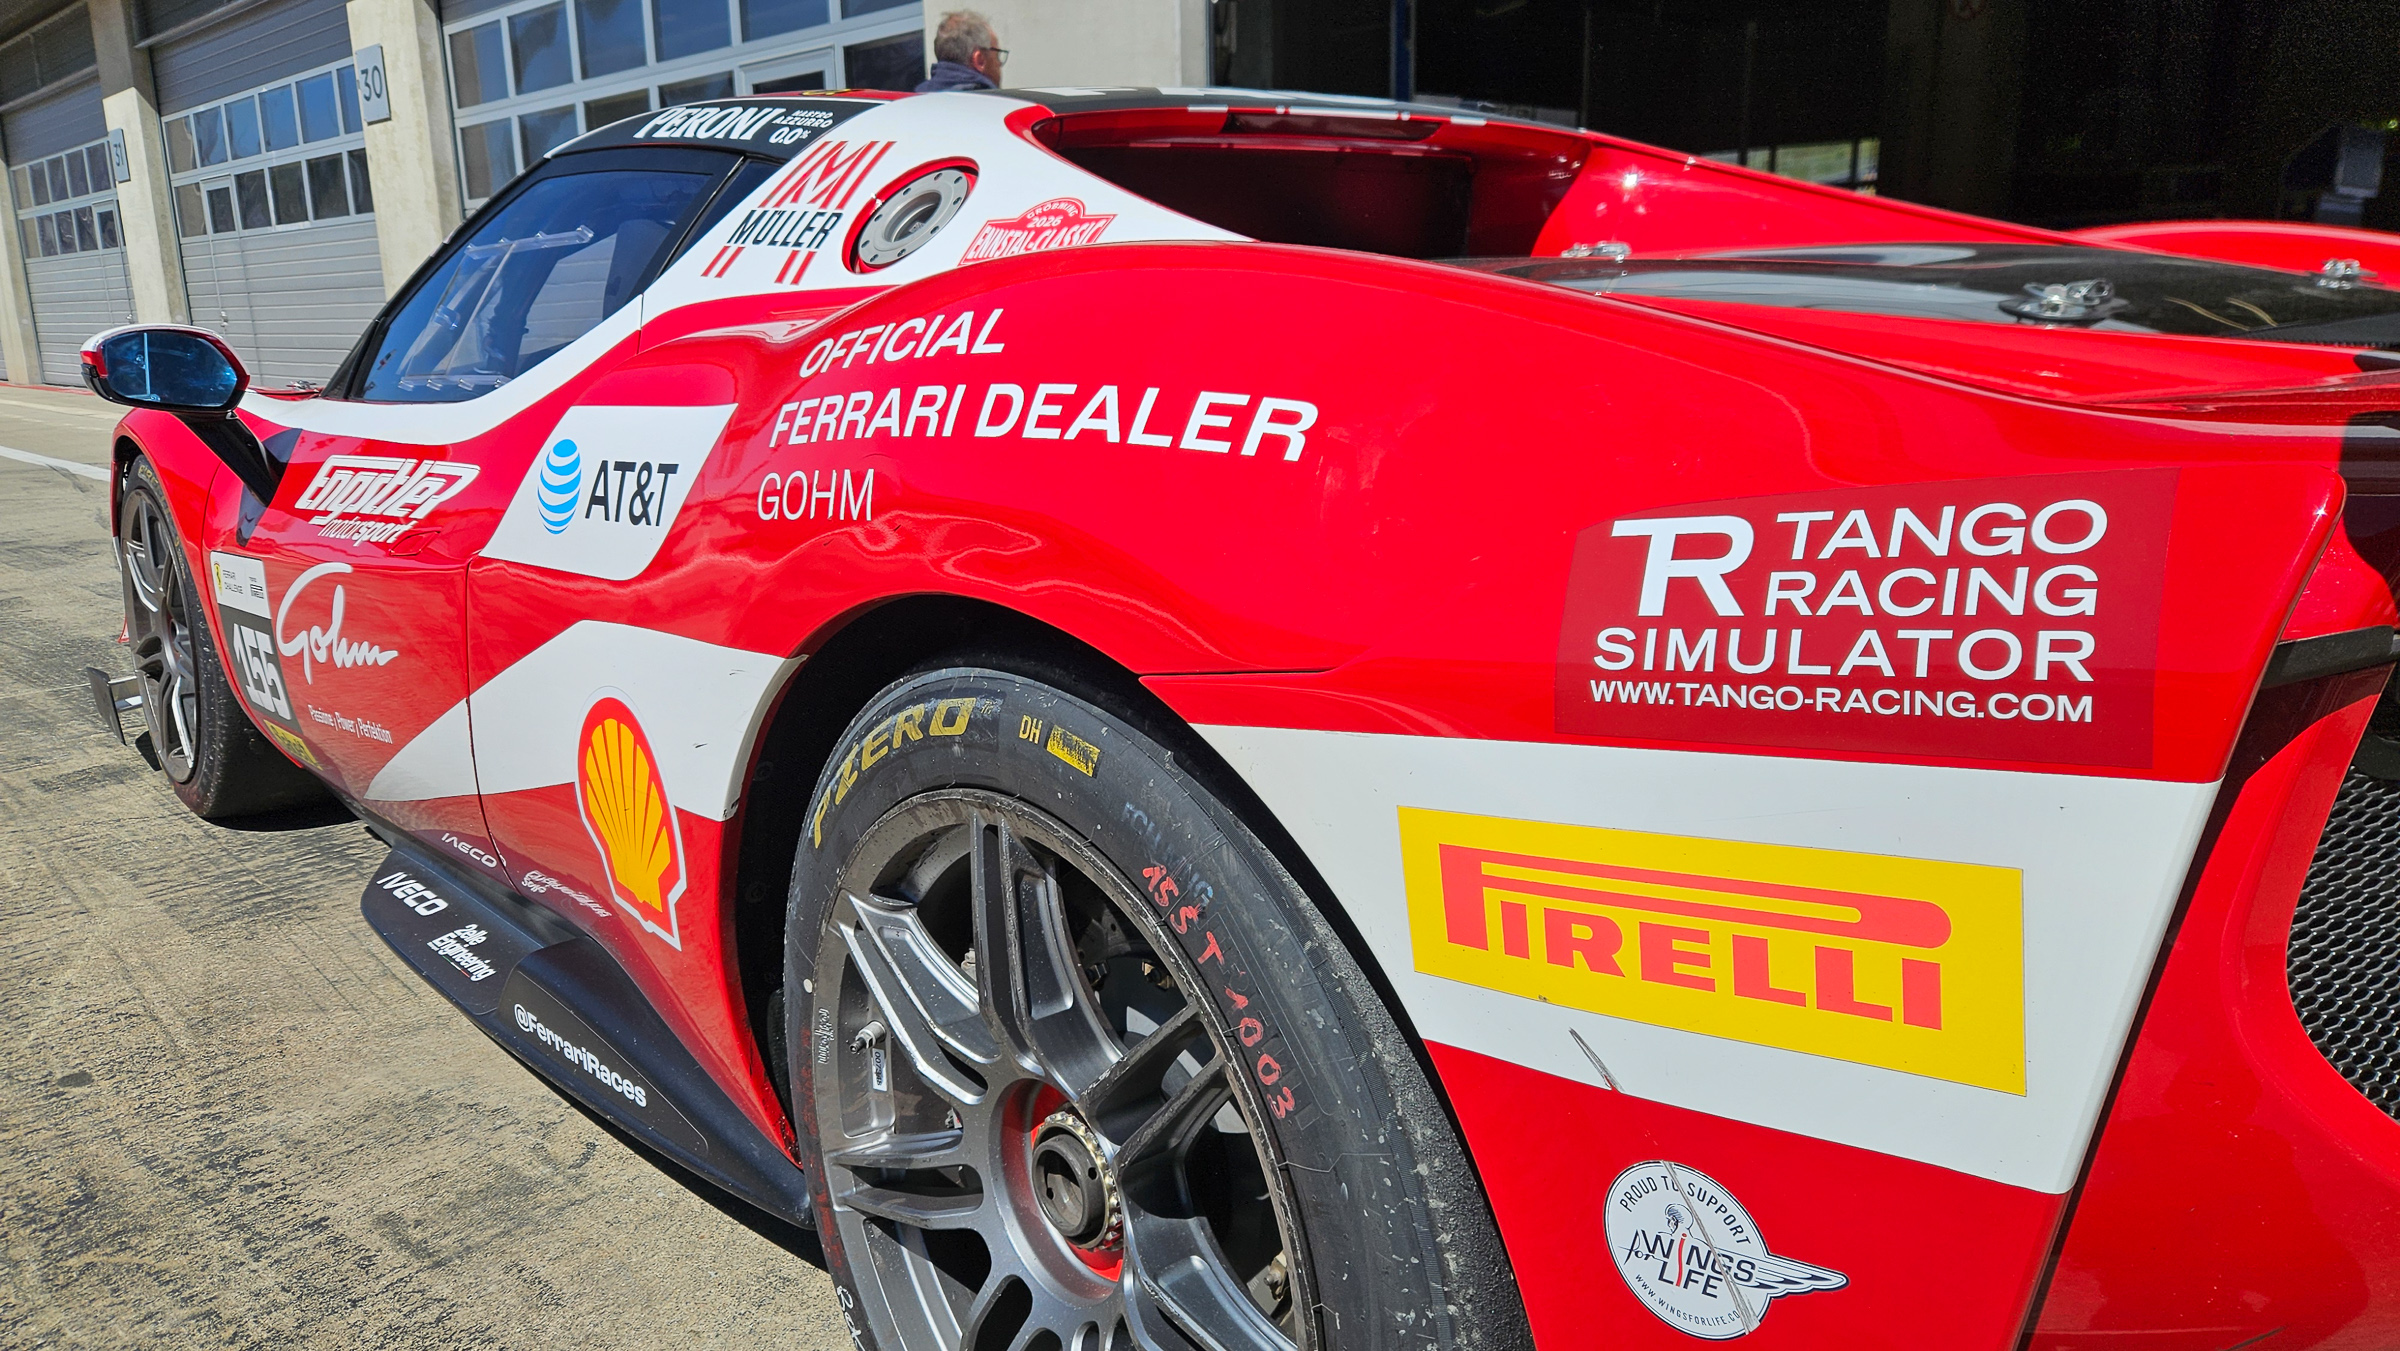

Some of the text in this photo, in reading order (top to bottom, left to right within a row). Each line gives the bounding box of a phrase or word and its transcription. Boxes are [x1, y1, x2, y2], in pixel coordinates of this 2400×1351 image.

[360, 65, 383, 102] 30
[633, 106, 786, 141] PERONI
[768, 126, 812, 145] 0.0%
[771, 115, 834, 129] AZZURRO
[791, 109, 834, 119] NASTRO
[113, 143, 125, 168] 31
[726, 209, 843, 249] MÜLLER
[1027, 215, 1063, 228] 2026
[799, 308, 1006, 379] OFFICIAL
[769, 383, 1319, 462] FERRARI DEALER
[294, 455, 481, 525] Engstler
[585, 460, 680, 527] AT&T
[757, 468, 874, 521] GOHM
[317, 516, 419, 547] motorsport
[1776, 499, 2108, 561] TANGO
[1764, 564, 2099, 617] RACING
[275, 562, 399, 685] Gohm
[233, 623, 292, 721] 155
[1593, 627, 2095, 682] SIMULATOR
[308, 704, 334, 727] Passione
[335, 712, 356, 734] Power
[1590, 680, 2094, 723] WWW.TANGO-RACING.COM
[1019, 714, 1043, 745] DH
[376, 871, 449, 917] IVECO
[427, 932, 496, 982] Engineering
[457, 923, 489, 946] 2elle
[1438, 842, 1952, 1031] PIRELLI
[514, 1003, 648, 1108] @FerrariRaces
[1620, 1176, 1658, 1212] PROUD
[1687, 1182, 1752, 1245] SUPPORT
[1635, 1274, 1741, 1327] WWW.WINGSFORLIFE.CO
